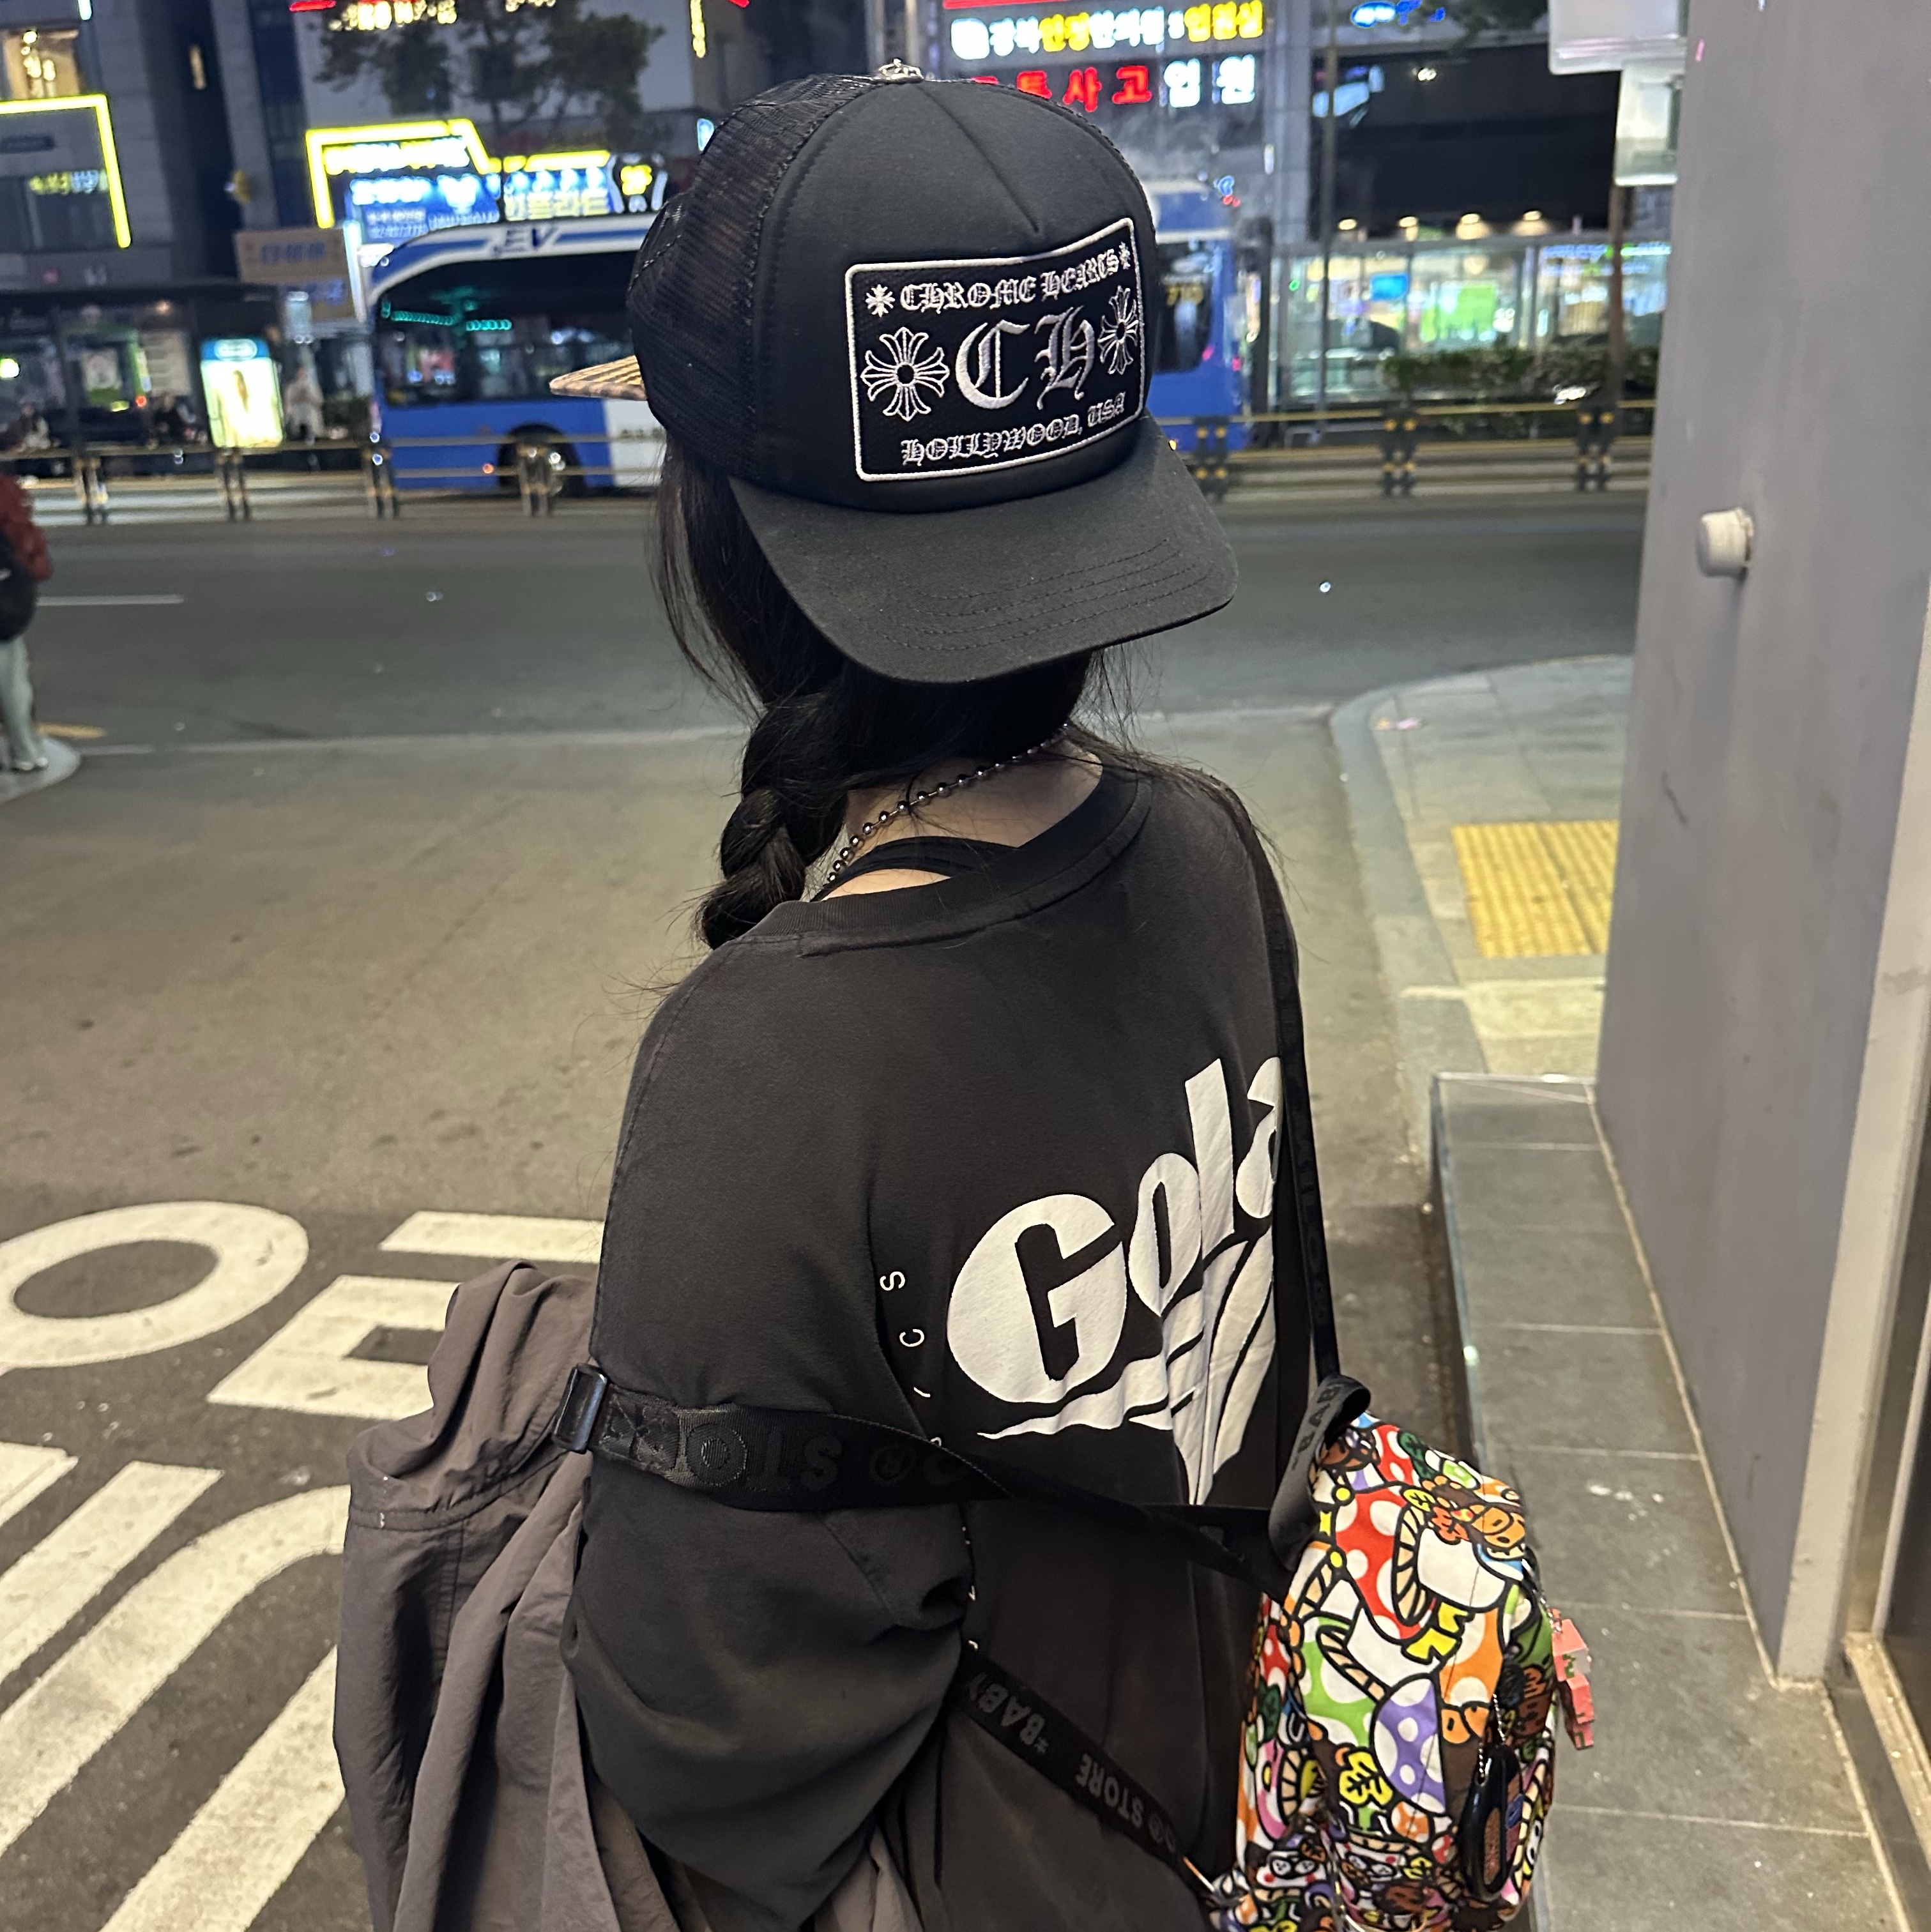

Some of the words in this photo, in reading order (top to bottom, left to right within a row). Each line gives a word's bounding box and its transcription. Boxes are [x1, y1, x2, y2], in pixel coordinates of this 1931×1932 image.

[497, 226, 560, 253] EV
[900, 275, 1037, 314] CHROME
[1041, 247, 1120, 301] HEARTS
[1087, 391, 1127, 428] USA
[1074, 1753, 1145, 1829] STORE
